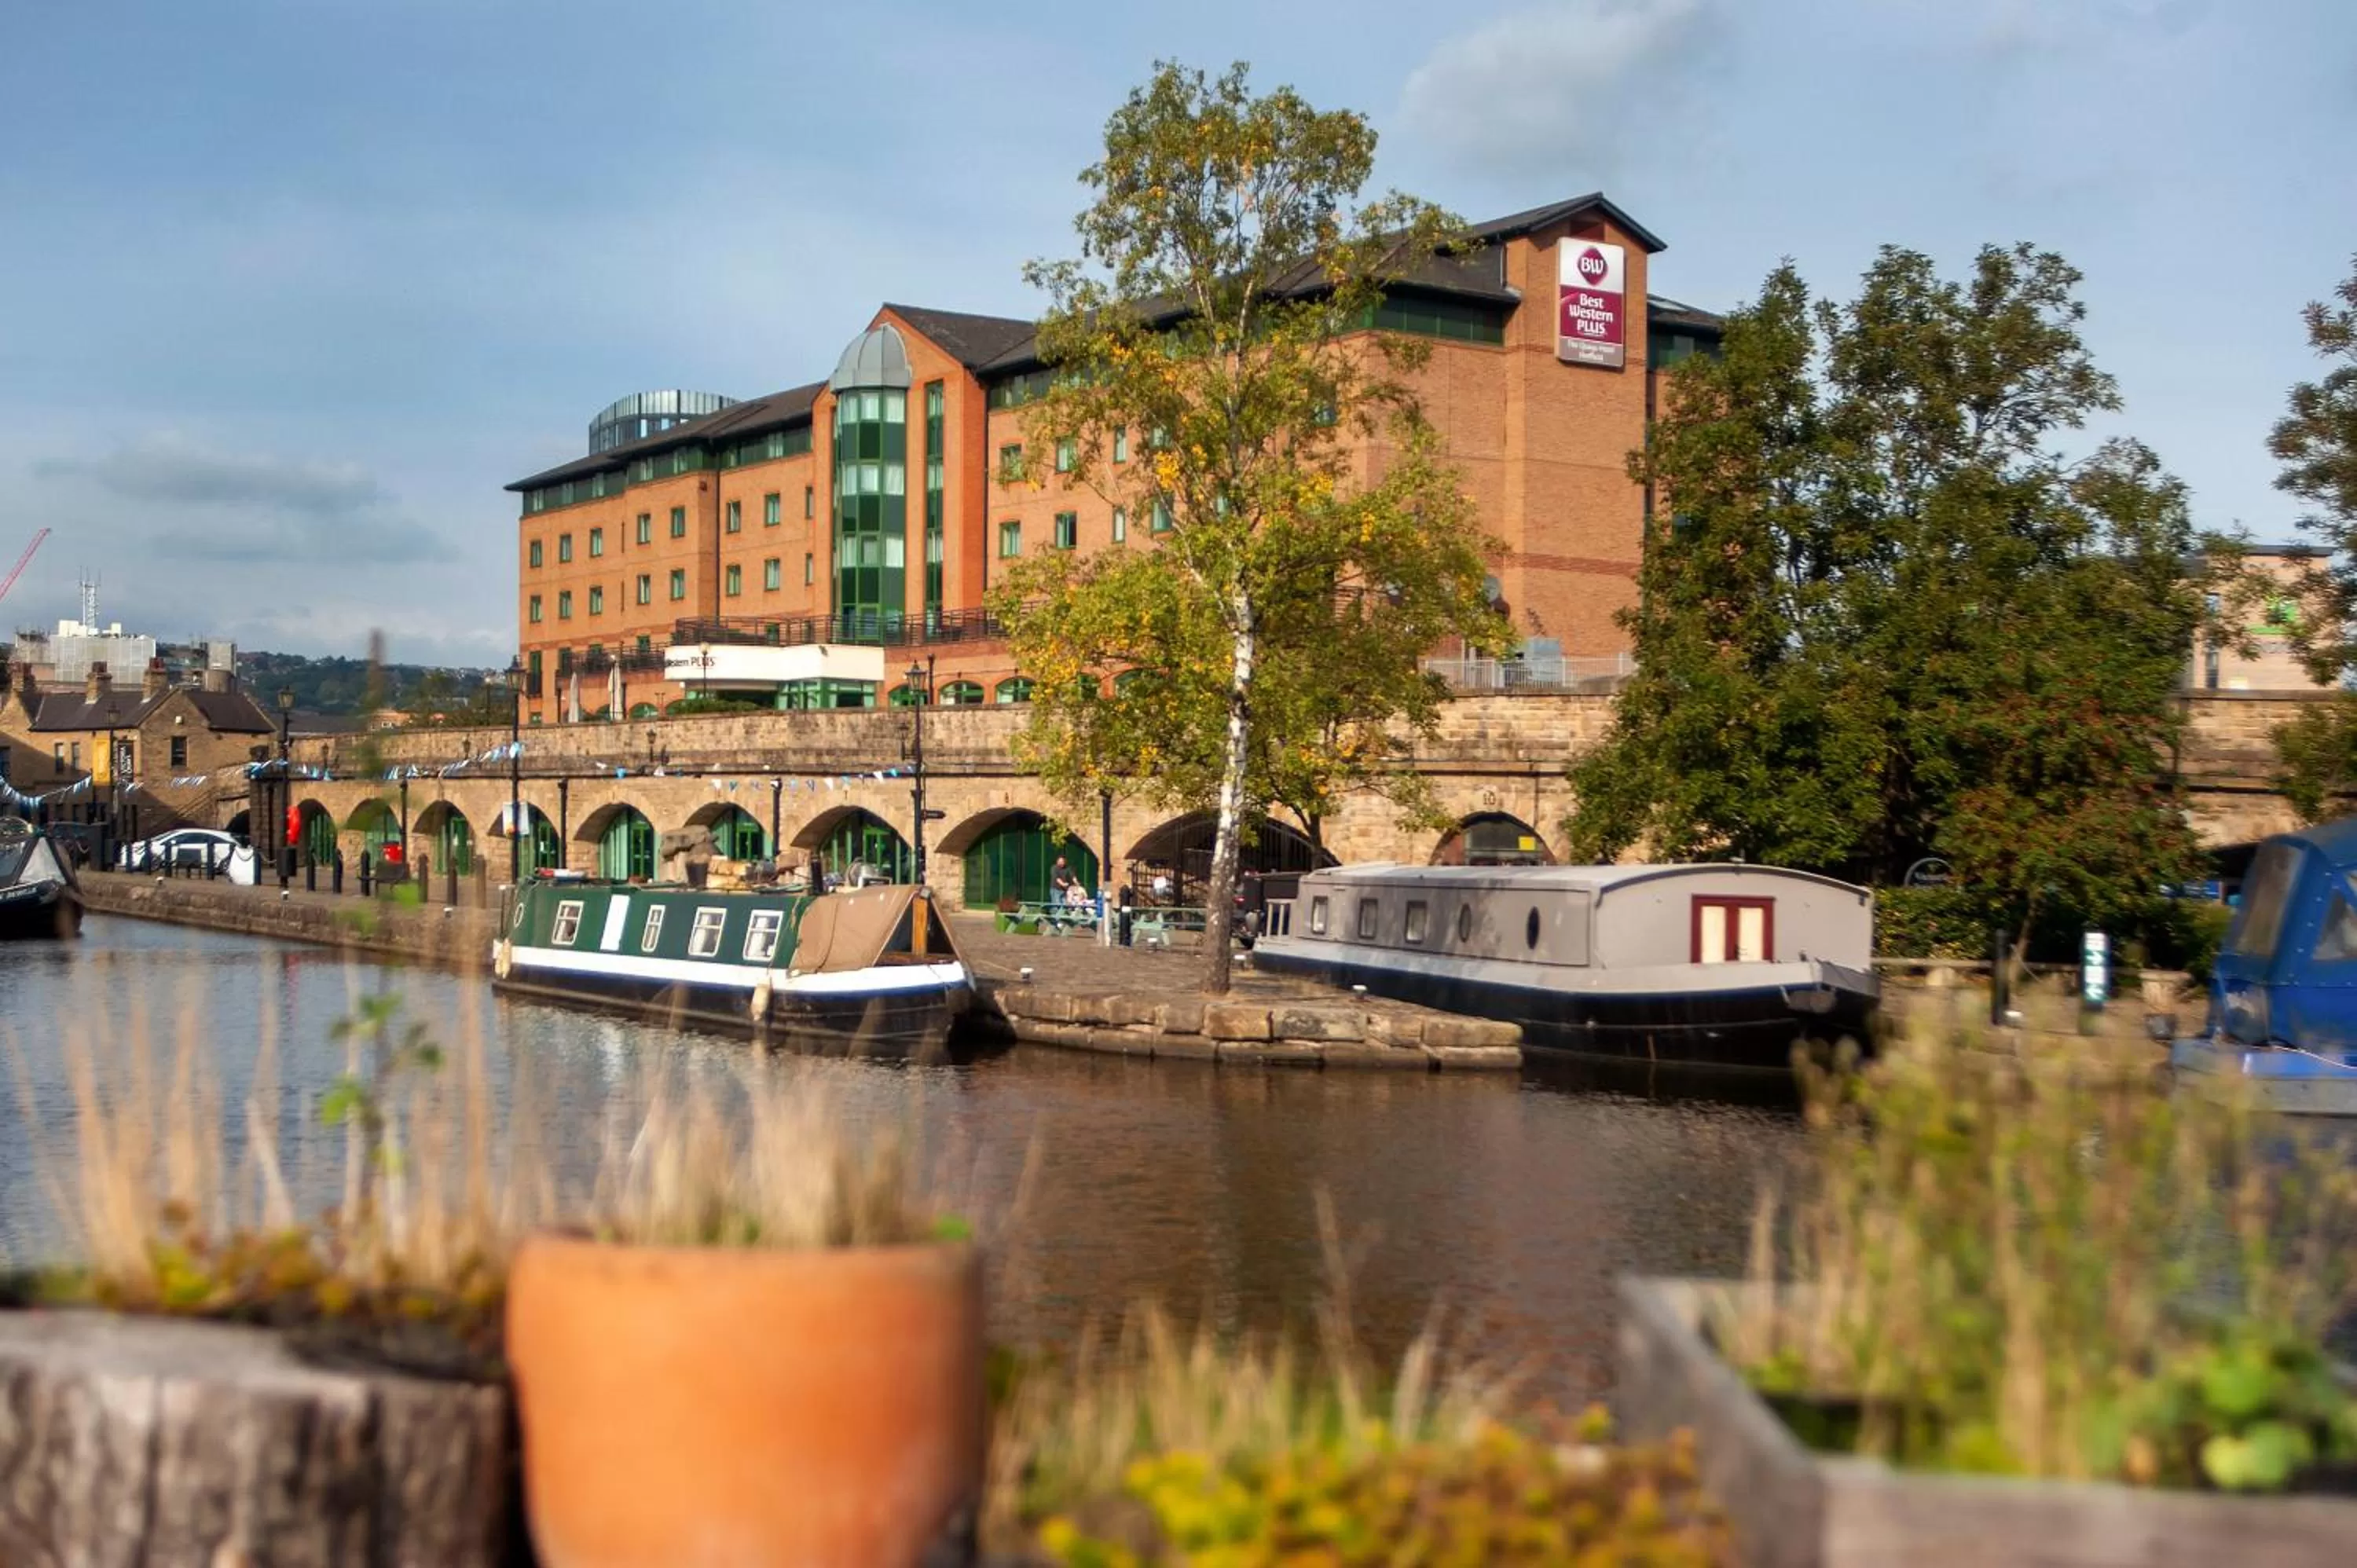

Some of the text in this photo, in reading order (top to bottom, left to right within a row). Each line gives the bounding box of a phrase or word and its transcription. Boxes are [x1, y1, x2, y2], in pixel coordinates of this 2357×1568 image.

[1581, 257, 1604, 274] BW
[1580, 293, 1604, 309] Best
[1569, 304, 1613, 323] Western
[1577, 319, 1605, 334] PLUS
[1483, 790, 1496, 805] 10
